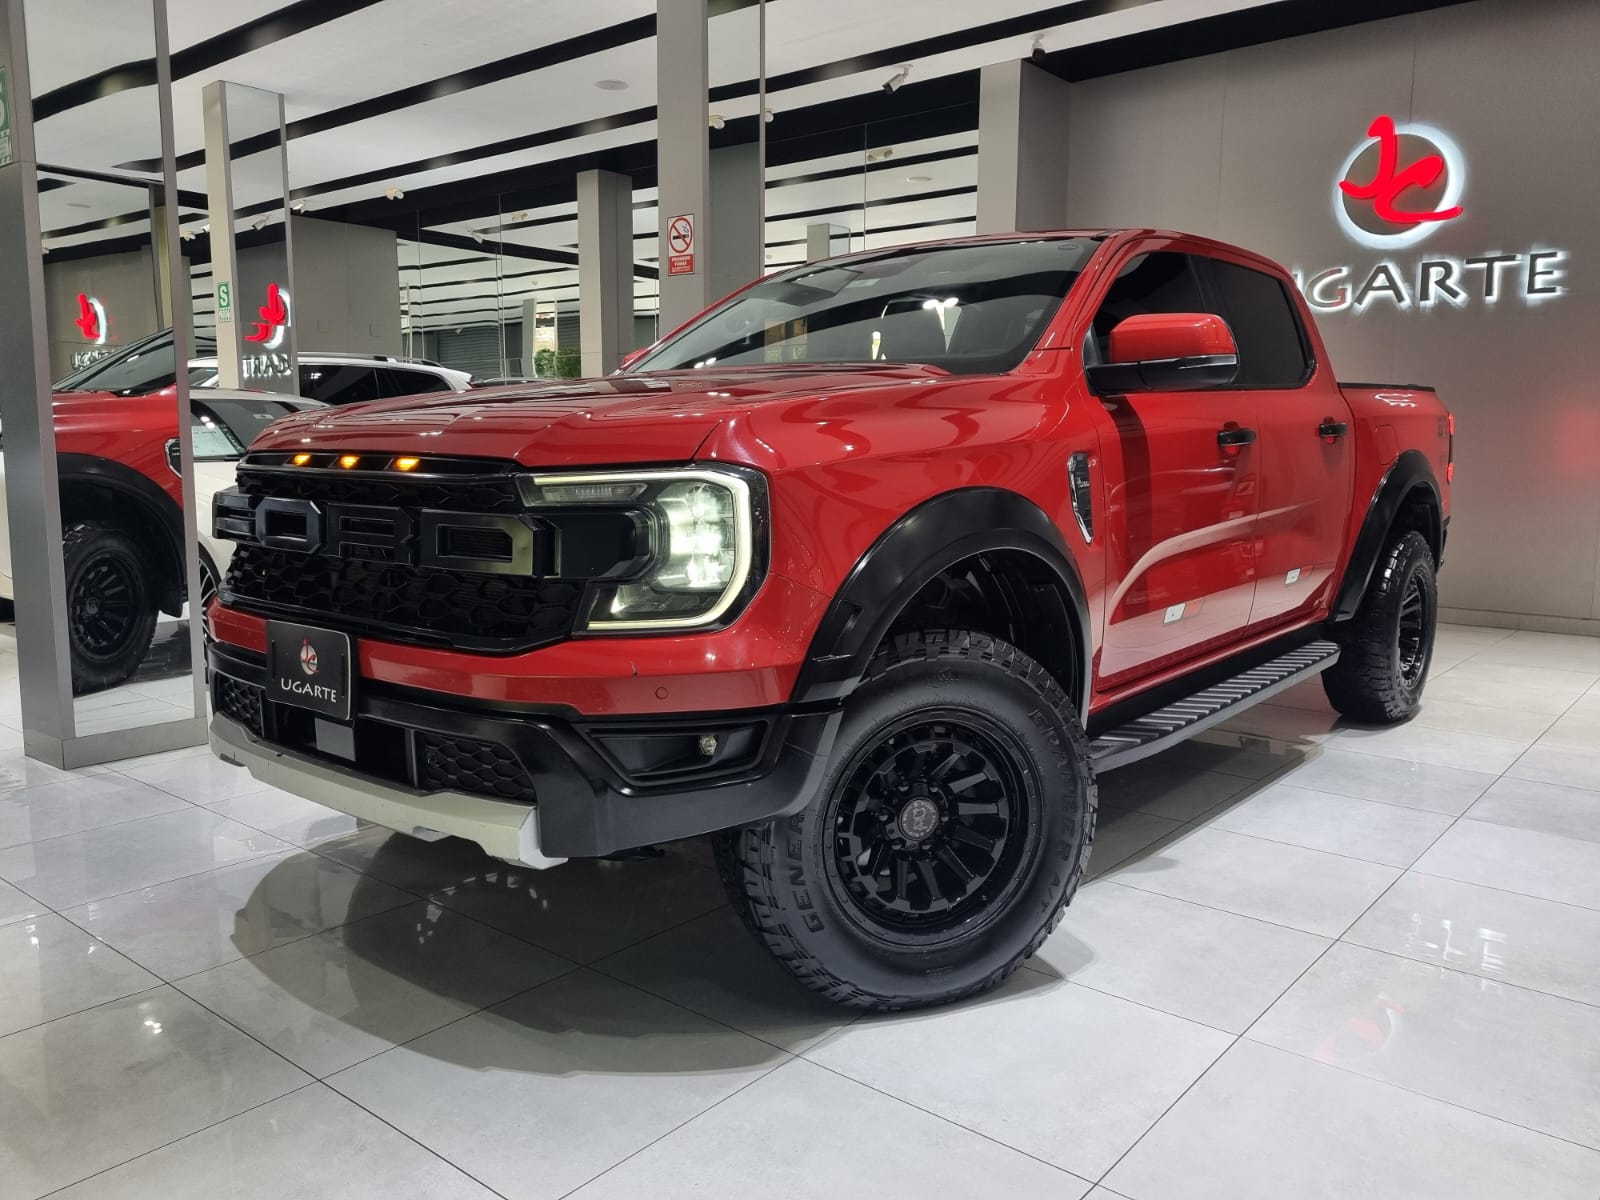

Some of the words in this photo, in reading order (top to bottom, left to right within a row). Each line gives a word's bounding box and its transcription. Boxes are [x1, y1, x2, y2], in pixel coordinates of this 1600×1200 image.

[1292, 250, 1562, 312] GARTE
[219, 285, 229, 307] S
[281, 677, 337, 703] UGARTE
